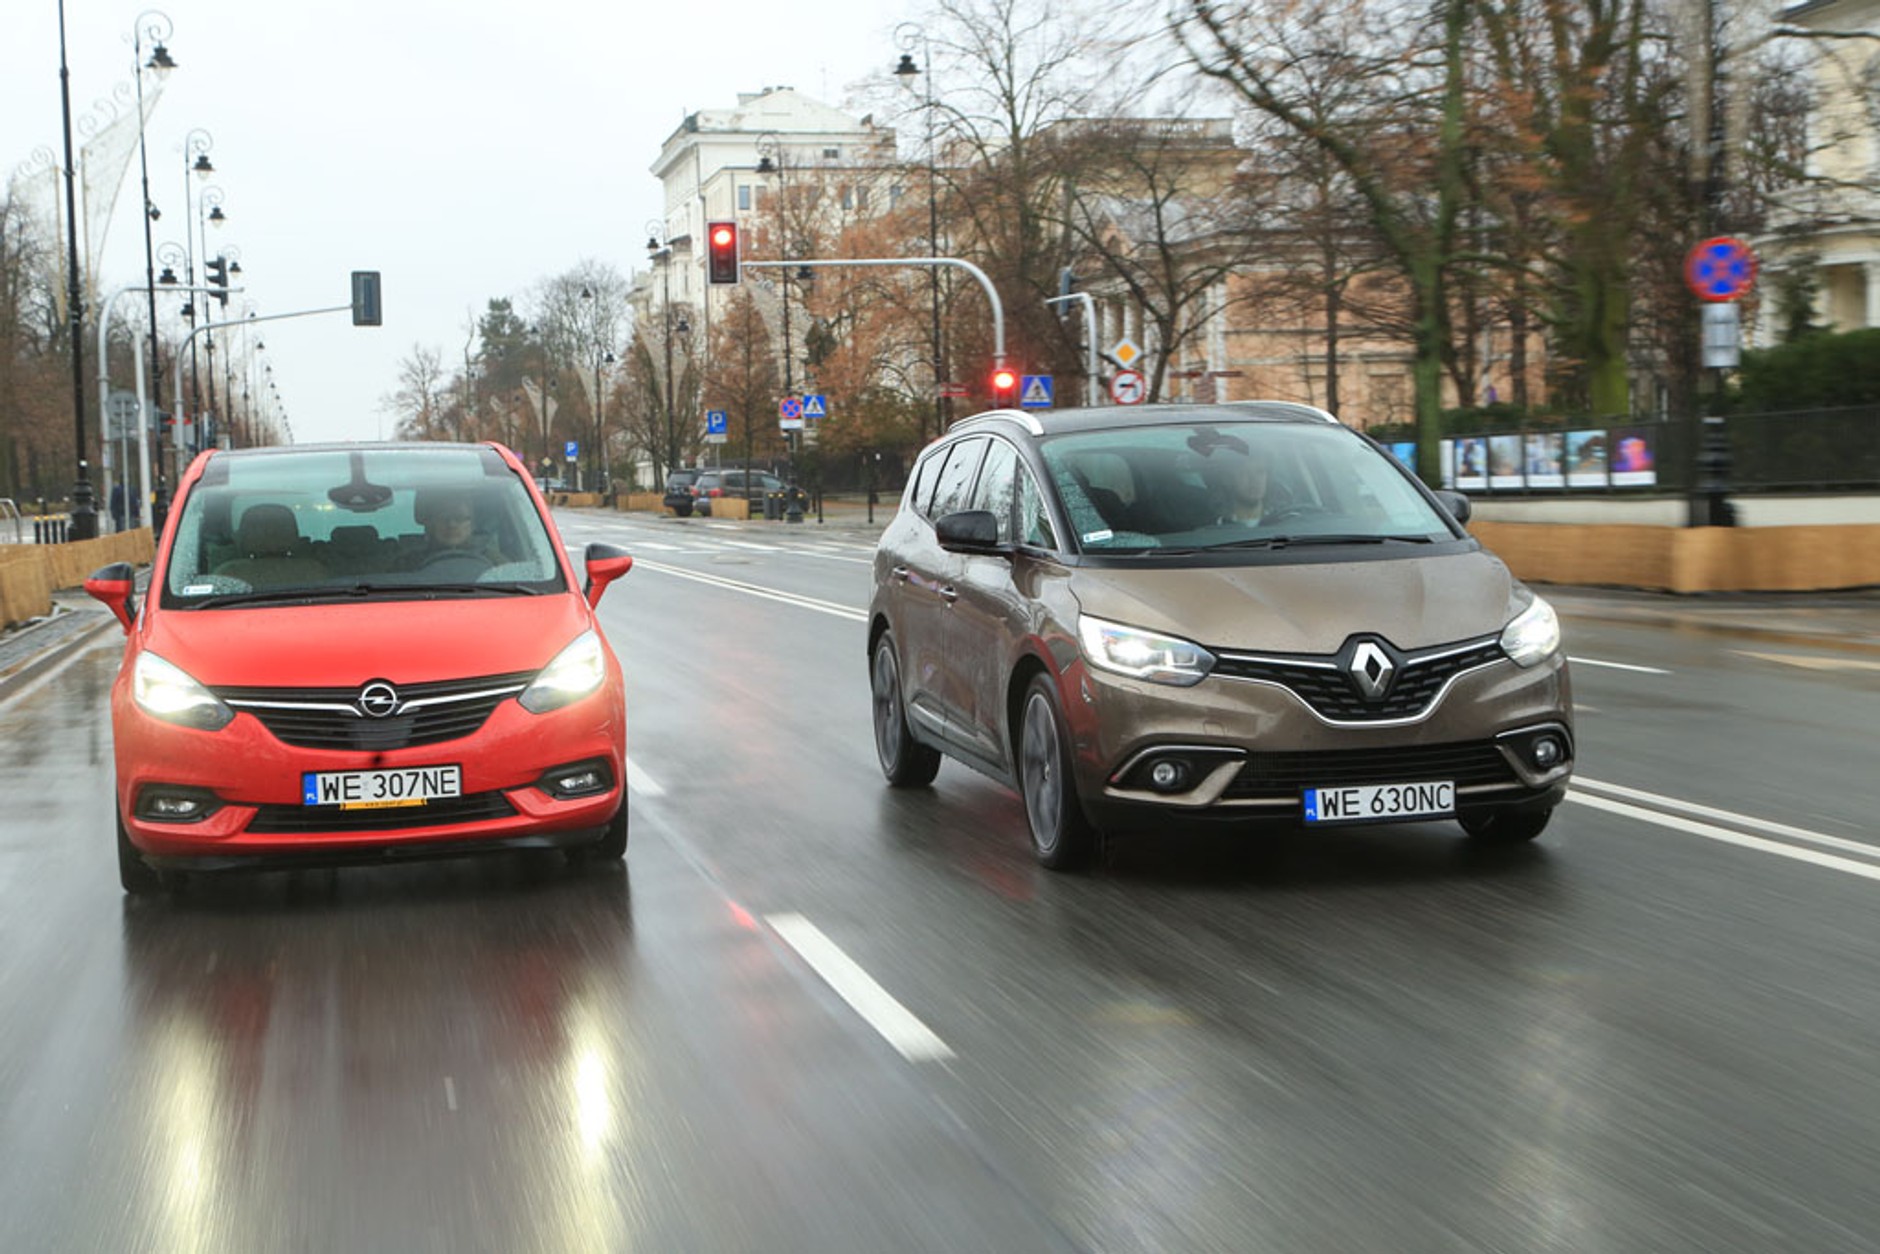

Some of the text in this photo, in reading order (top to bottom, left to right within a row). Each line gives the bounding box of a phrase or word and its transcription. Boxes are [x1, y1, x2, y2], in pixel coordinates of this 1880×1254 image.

[712, 412, 723, 428] P
[567, 442, 576, 452] P
[321, 769, 457, 801] WE 307NE
[1321, 784, 1451, 817] WE 630NC
